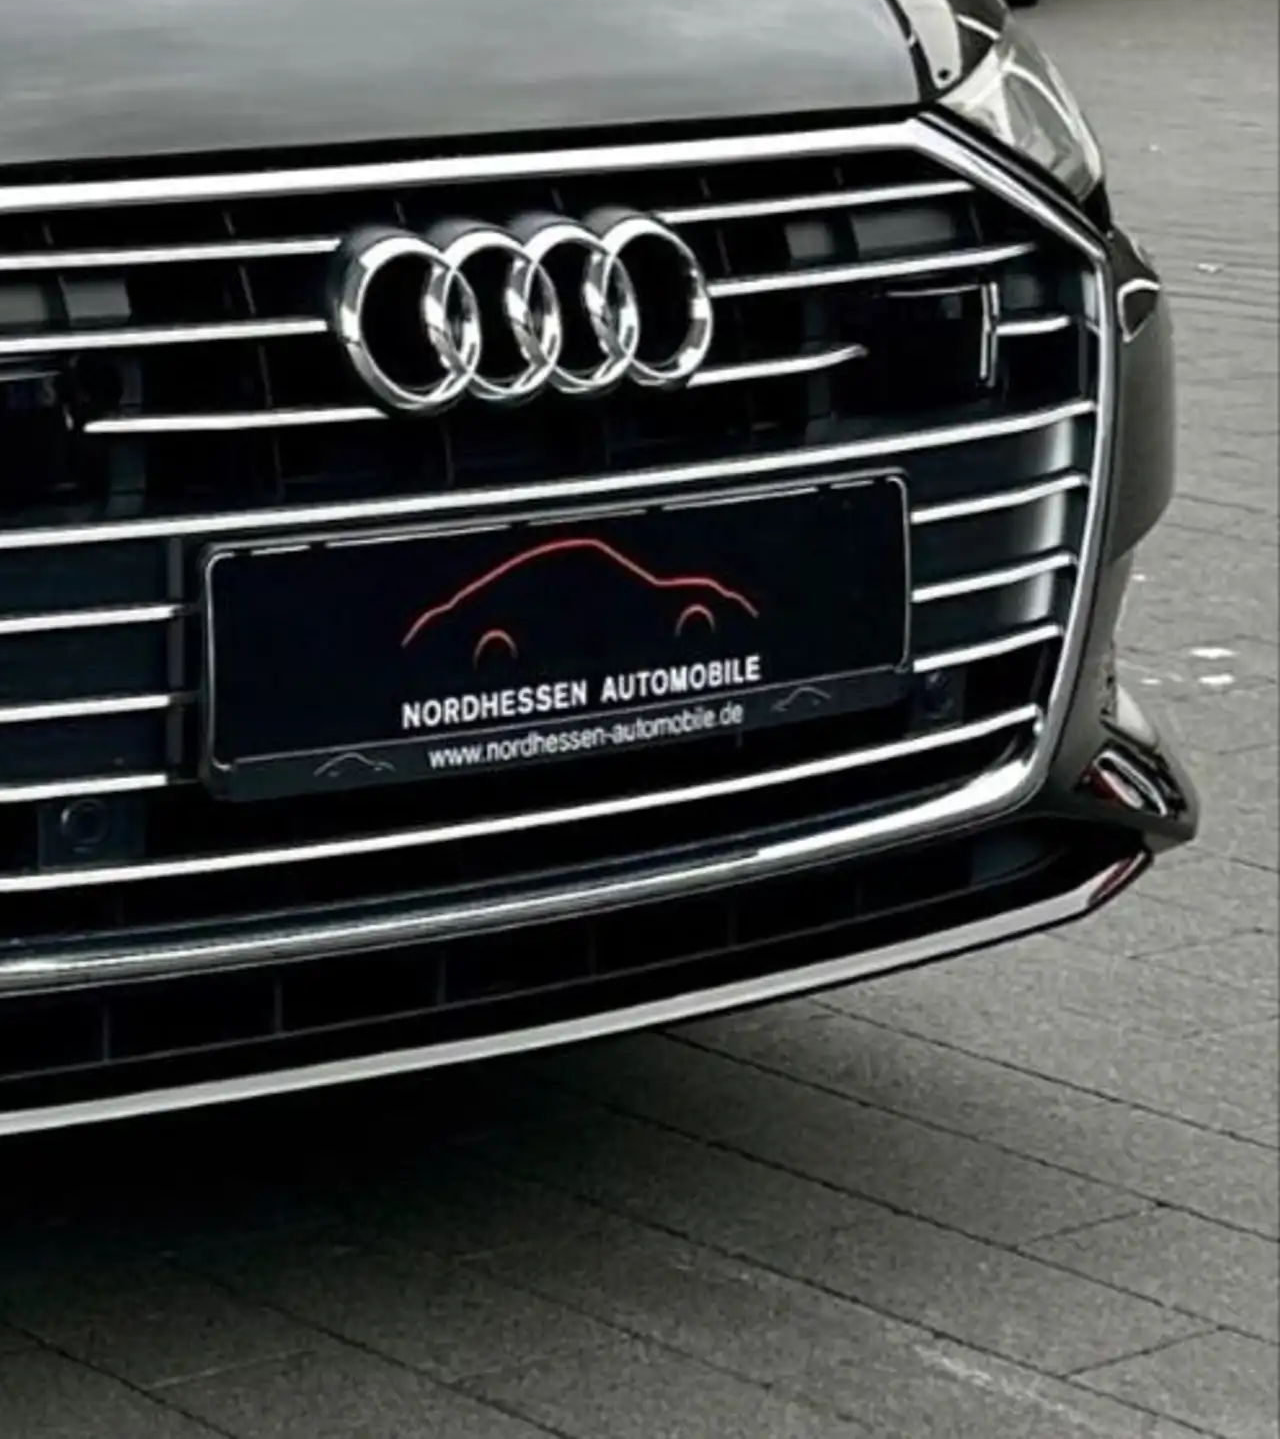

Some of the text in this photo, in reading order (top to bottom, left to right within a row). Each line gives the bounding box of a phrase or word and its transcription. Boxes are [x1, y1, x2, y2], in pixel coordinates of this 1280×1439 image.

[401, 655, 762, 730] NORDHESSEN AUTOMOBILE
[427, 700, 745, 770] www.nordhessen-automobile.de
